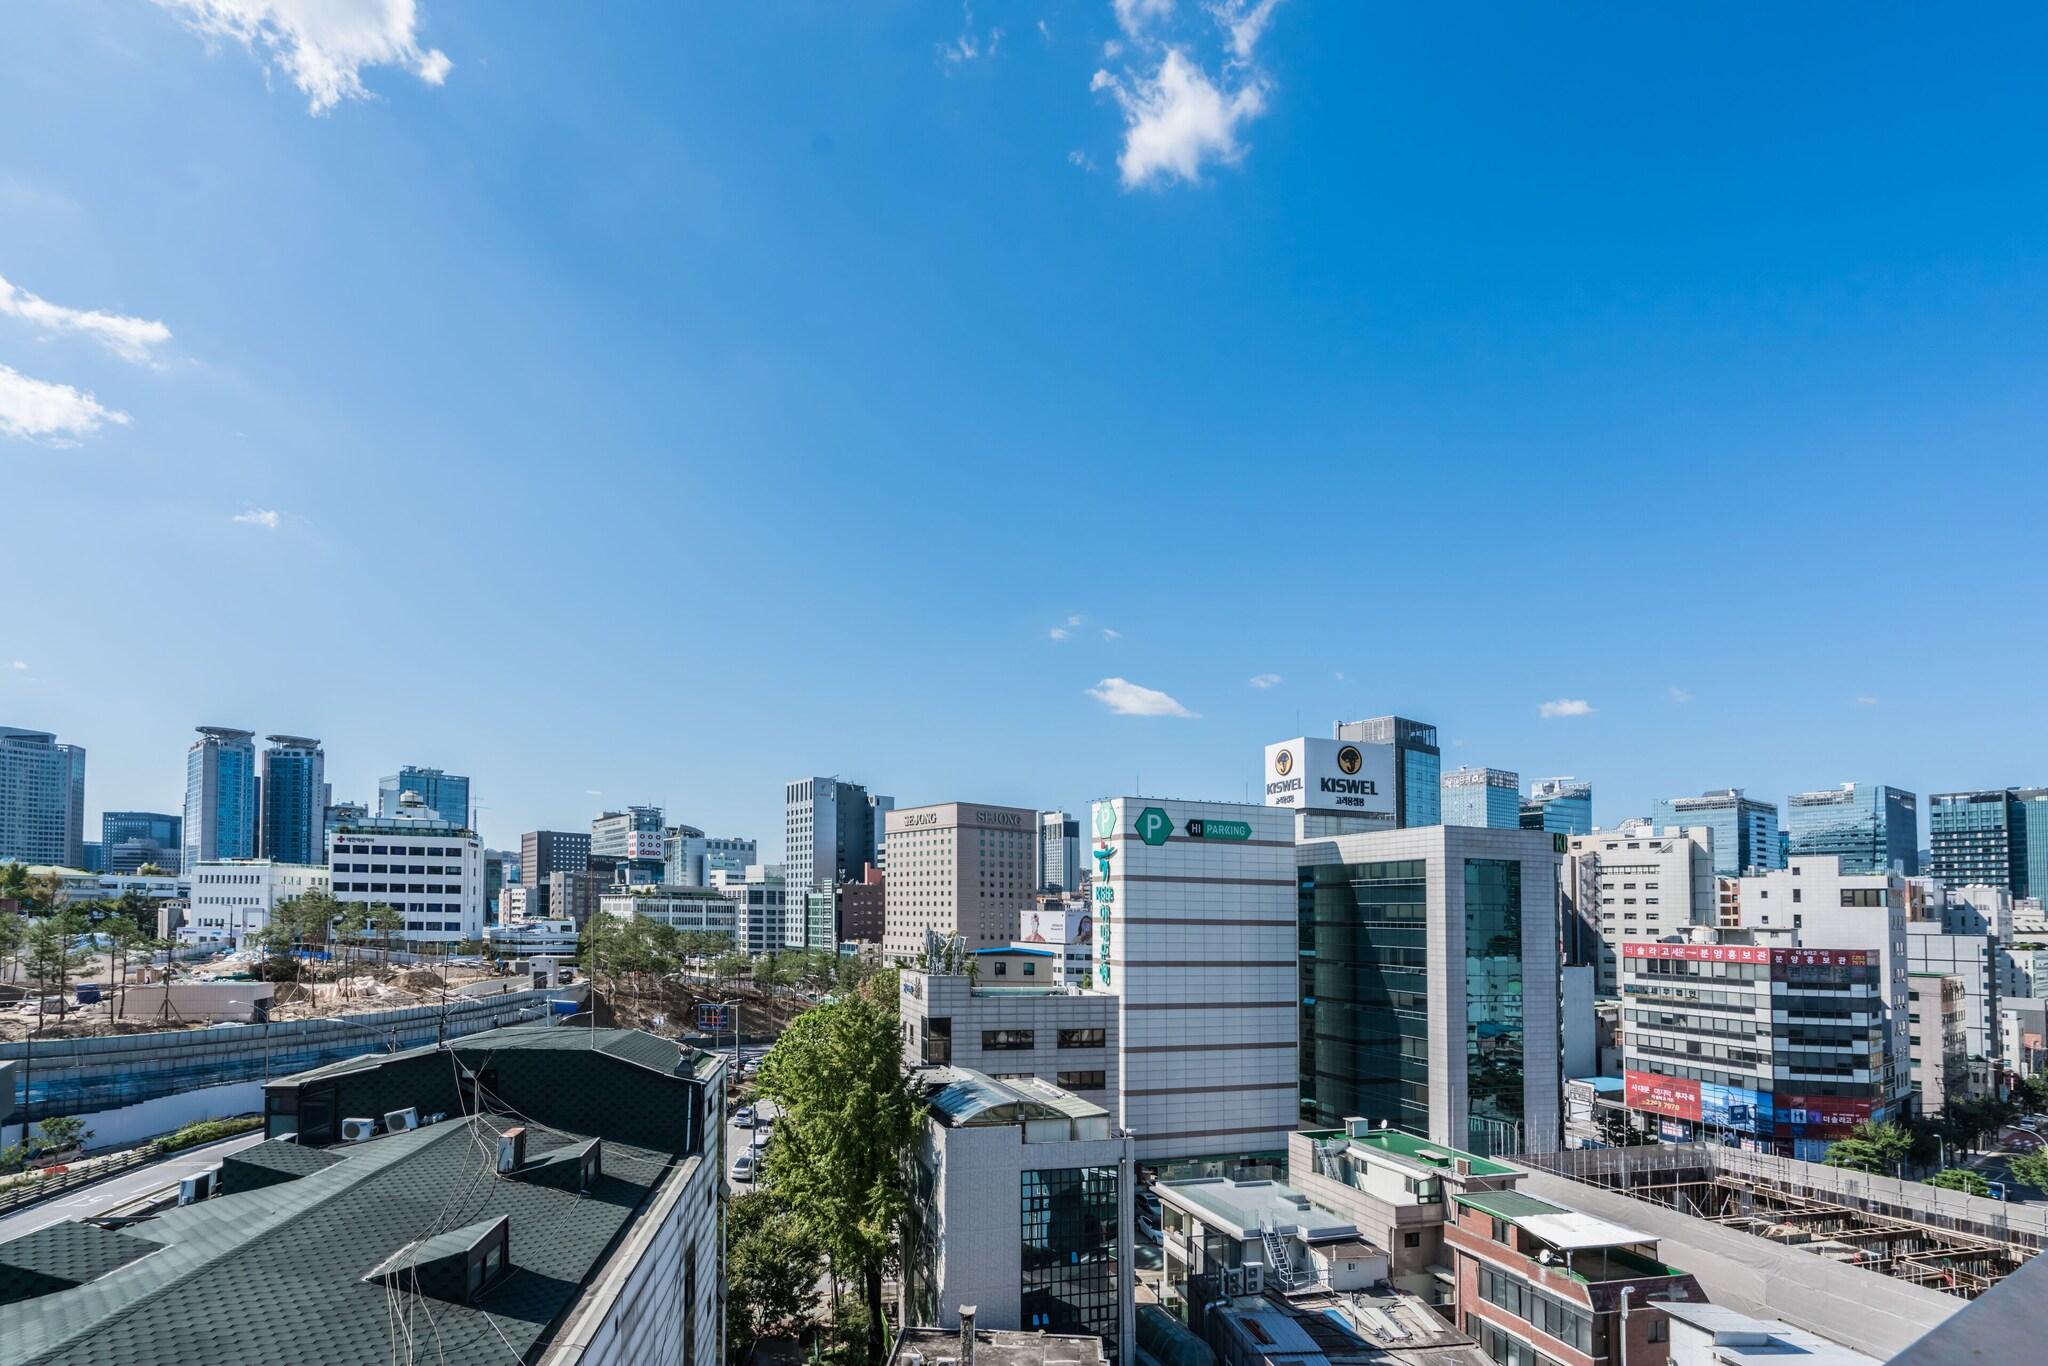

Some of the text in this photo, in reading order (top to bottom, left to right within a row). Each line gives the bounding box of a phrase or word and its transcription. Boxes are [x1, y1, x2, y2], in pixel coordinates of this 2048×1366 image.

[1266, 778, 1303, 795] KISWEL
[1320, 777, 1379, 796] KISWEL
[904, 813, 937, 827] SEJONG
[976, 810, 1021, 825] SEJONG
[1146, 814, 1162, 839] P
[1191, 823, 1246, 836] HI PARKING
[640, 848, 661, 857] daiso
[1700, 948, 1767, 961] 분양홍보관
